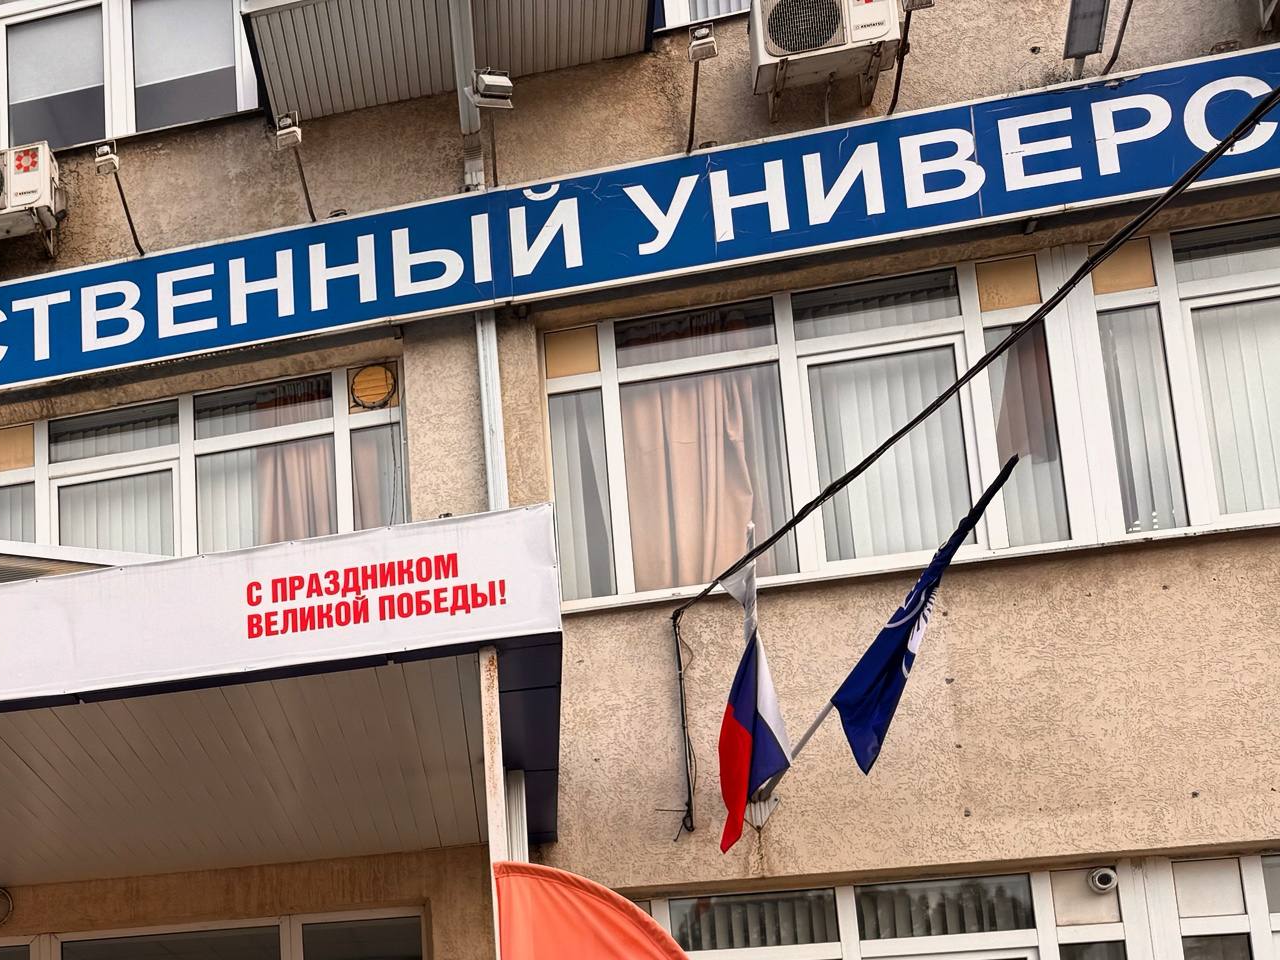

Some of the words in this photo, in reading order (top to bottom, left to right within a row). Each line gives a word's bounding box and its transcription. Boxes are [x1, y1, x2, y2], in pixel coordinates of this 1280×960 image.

[623, 75, 1279, 256] УНИВЕРС
[246, 581, 262, 607] С
[271, 552, 459, 604] ПРАЗДНИКОМ
[247, 595, 369, 639] ВЕЛИКОЙ
[379, 579, 507, 621] ПОБЕДЫ!
